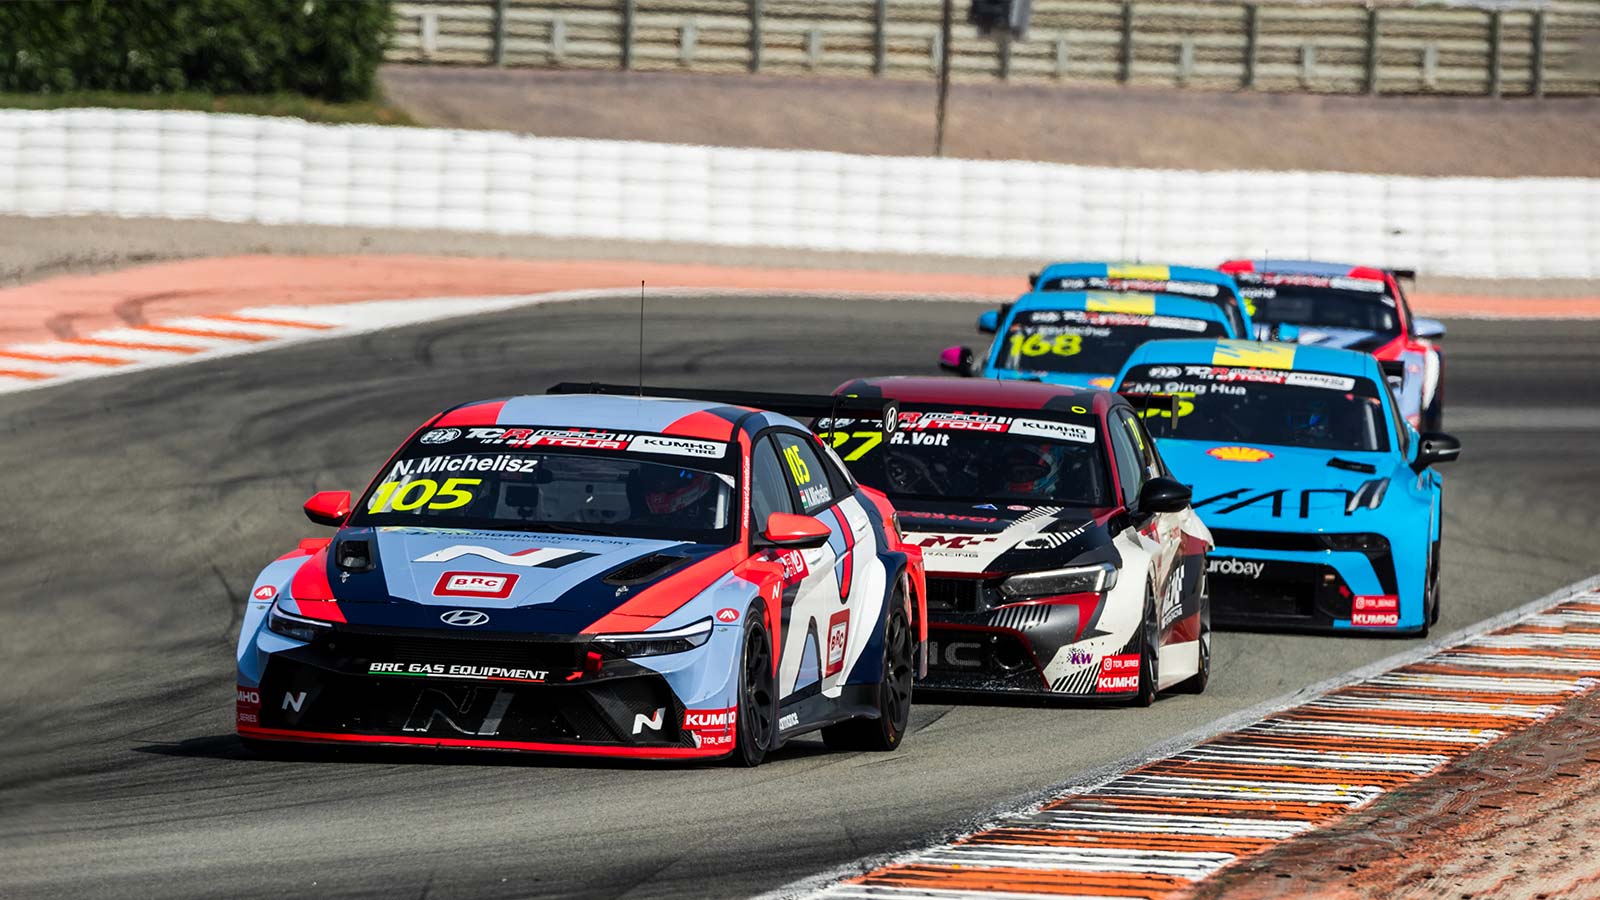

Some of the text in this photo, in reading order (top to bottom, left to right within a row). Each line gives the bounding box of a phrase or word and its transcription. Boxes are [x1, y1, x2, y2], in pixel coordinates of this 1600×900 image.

[1010, 333, 1083, 357] 168
[1135, 381, 1247, 395] Ma Qing Hua
[935, 420, 1002, 431] TOUR
[1022, 421, 1087, 434] KUMHO
[421, 428, 534, 444] FIA TCR
[890, 431, 950, 447] R.Volt
[1061, 431, 1088, 440] TIRE
[546, 437, 621, 449] TOUR
[644, 438, 717, 451] KUMHO
[685, 447, 717, 456] TIRE
[391, 454, 539, 477] N.Michelisz
[782, 444, 811, 487] 105
[368, 477, 483, 515] 105
[454, 577, 498, 587] BRC
[1352, 613, 1398, 625] KUMHO
[831, 630, 844, 651] BRC
[1071, 653, 1094, 665] KW
[369, 662, 549, 680] BRC GAS EQUIPMENT
[1099, 675, 1139, 688] KUMHO
